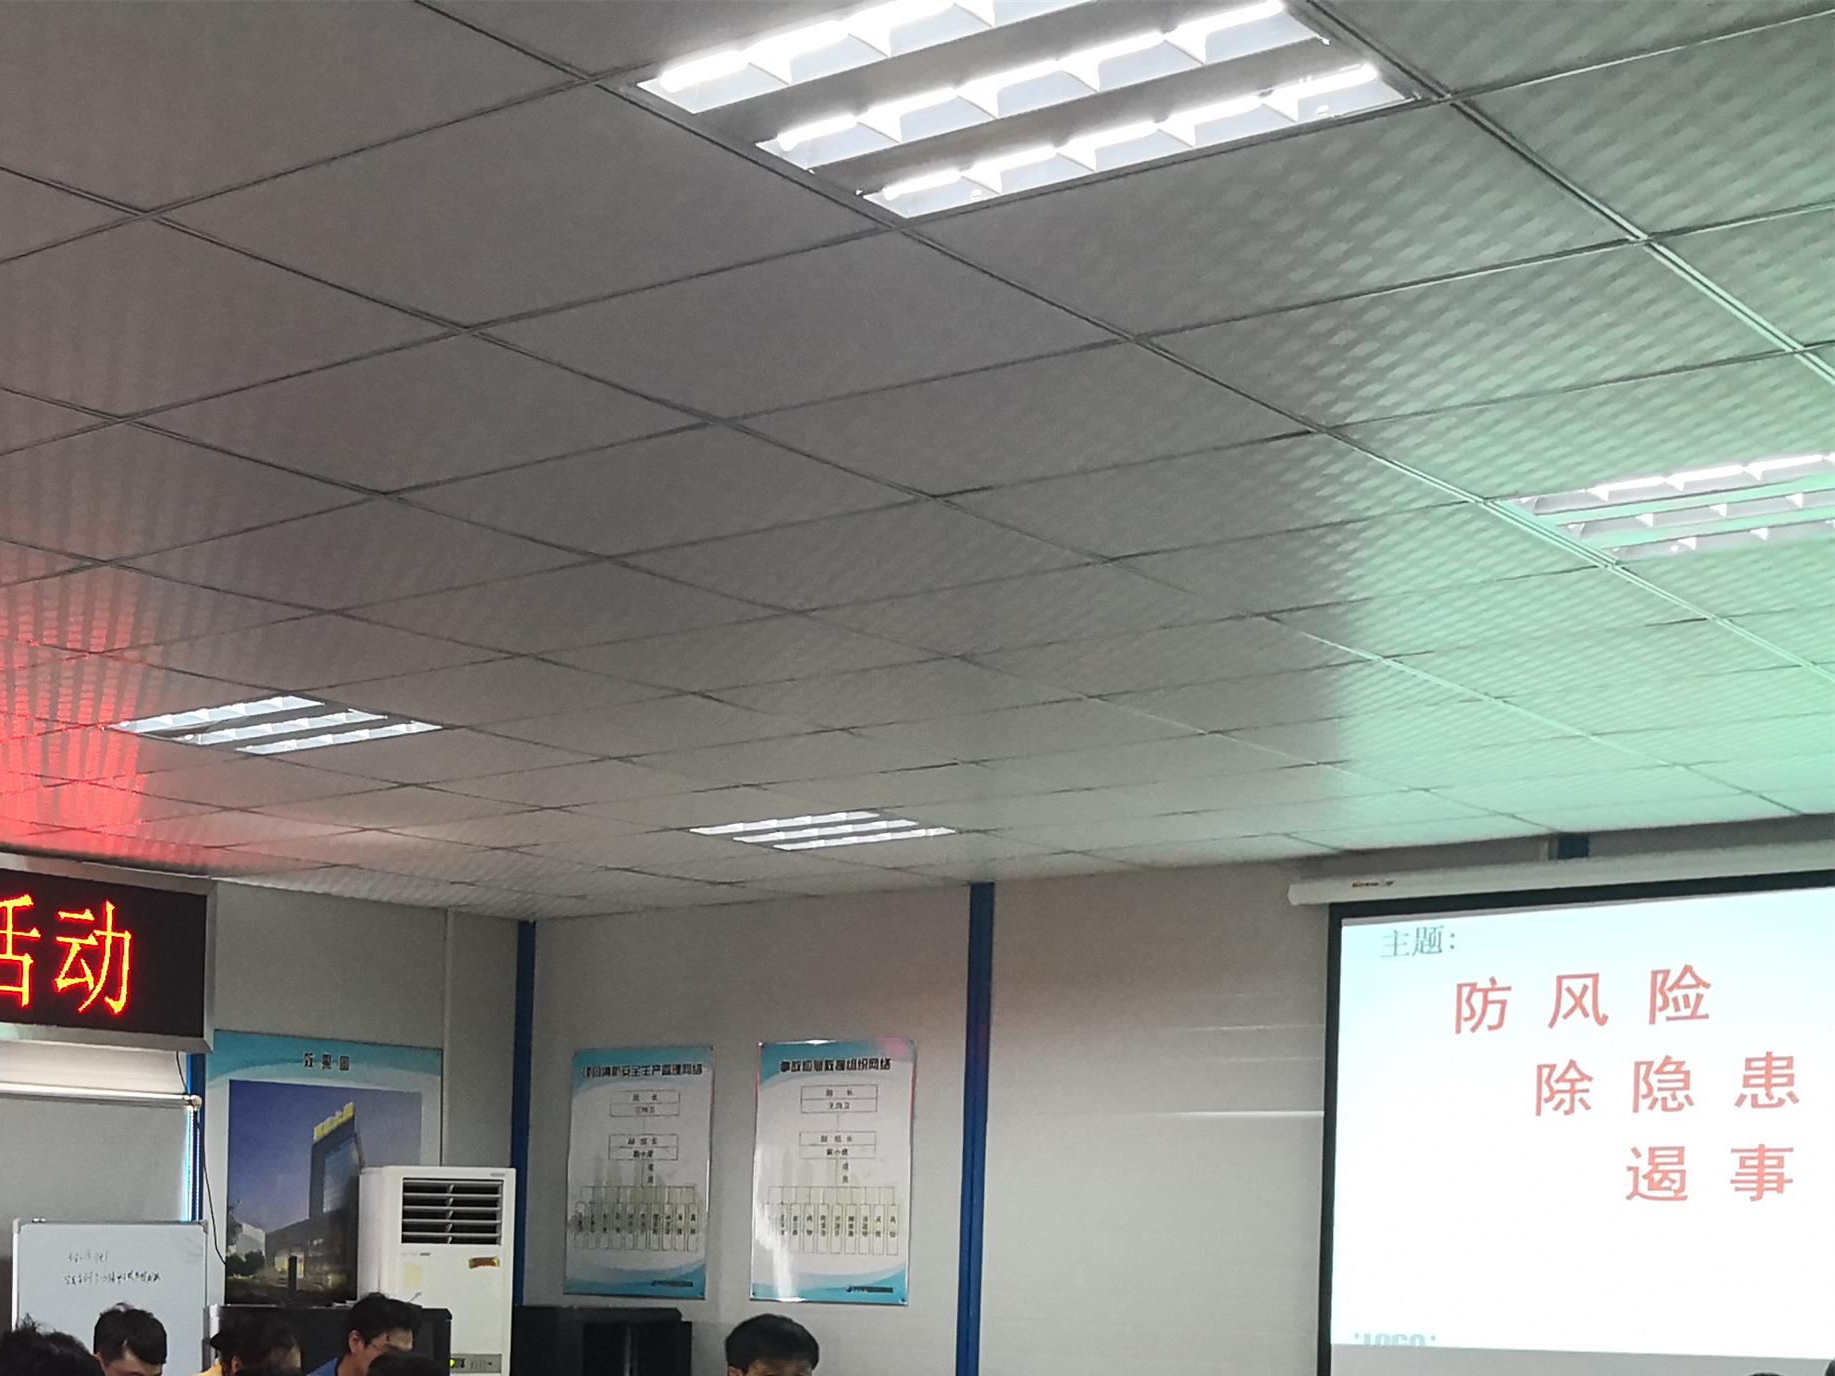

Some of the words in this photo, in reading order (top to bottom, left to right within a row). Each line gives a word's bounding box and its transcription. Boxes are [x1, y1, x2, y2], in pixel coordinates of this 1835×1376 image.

[1454, 964, 1712, 1034] 防风险
[1535, 1051, 1800, 1117] 除隐患
[1625, 1143, 1794, 1202] 遏事
